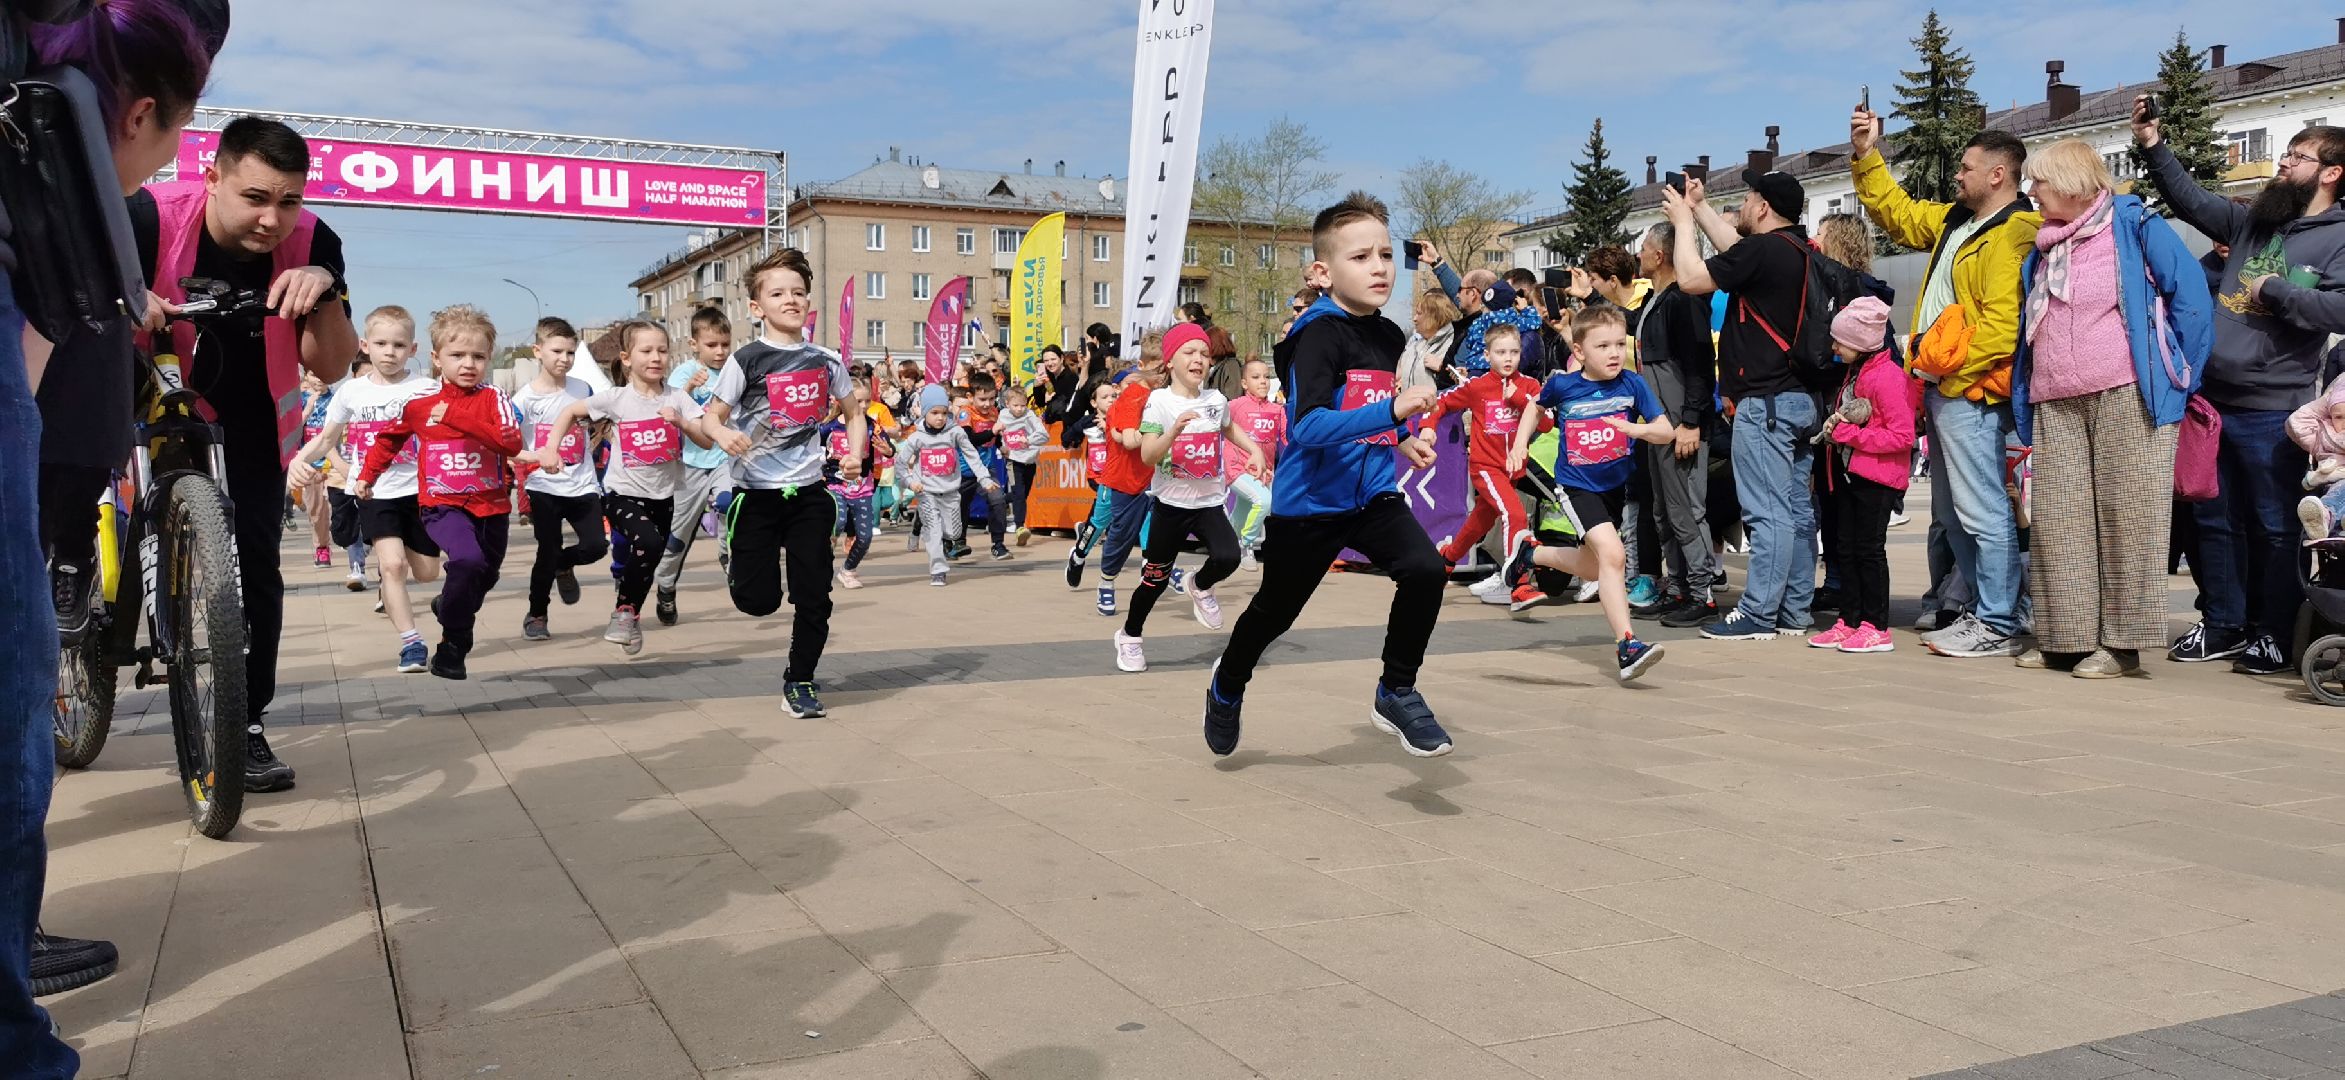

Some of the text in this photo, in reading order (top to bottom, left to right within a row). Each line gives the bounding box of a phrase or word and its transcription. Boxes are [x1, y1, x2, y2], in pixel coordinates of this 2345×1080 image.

[340, 150, 629, 208] ФИНИШ
[679, 182, 706, 194] AND
[707, 184, 747, 197] SPACE
[645, 192, 677, 204] HALF
[784, 382, 820, 403] 332
[1494, 407, 1520, 419] 324
[1254, 418, 1275, 430] 370
[631, 428, 668, 447] 382
[1578, 427, 1615, 446] 380
[1095, 451, 1107, 461] 37
[1184, 442, 1215, 459] 344
[440, 452, 483, 471] 352
[928, 454, 947, 464] 318
